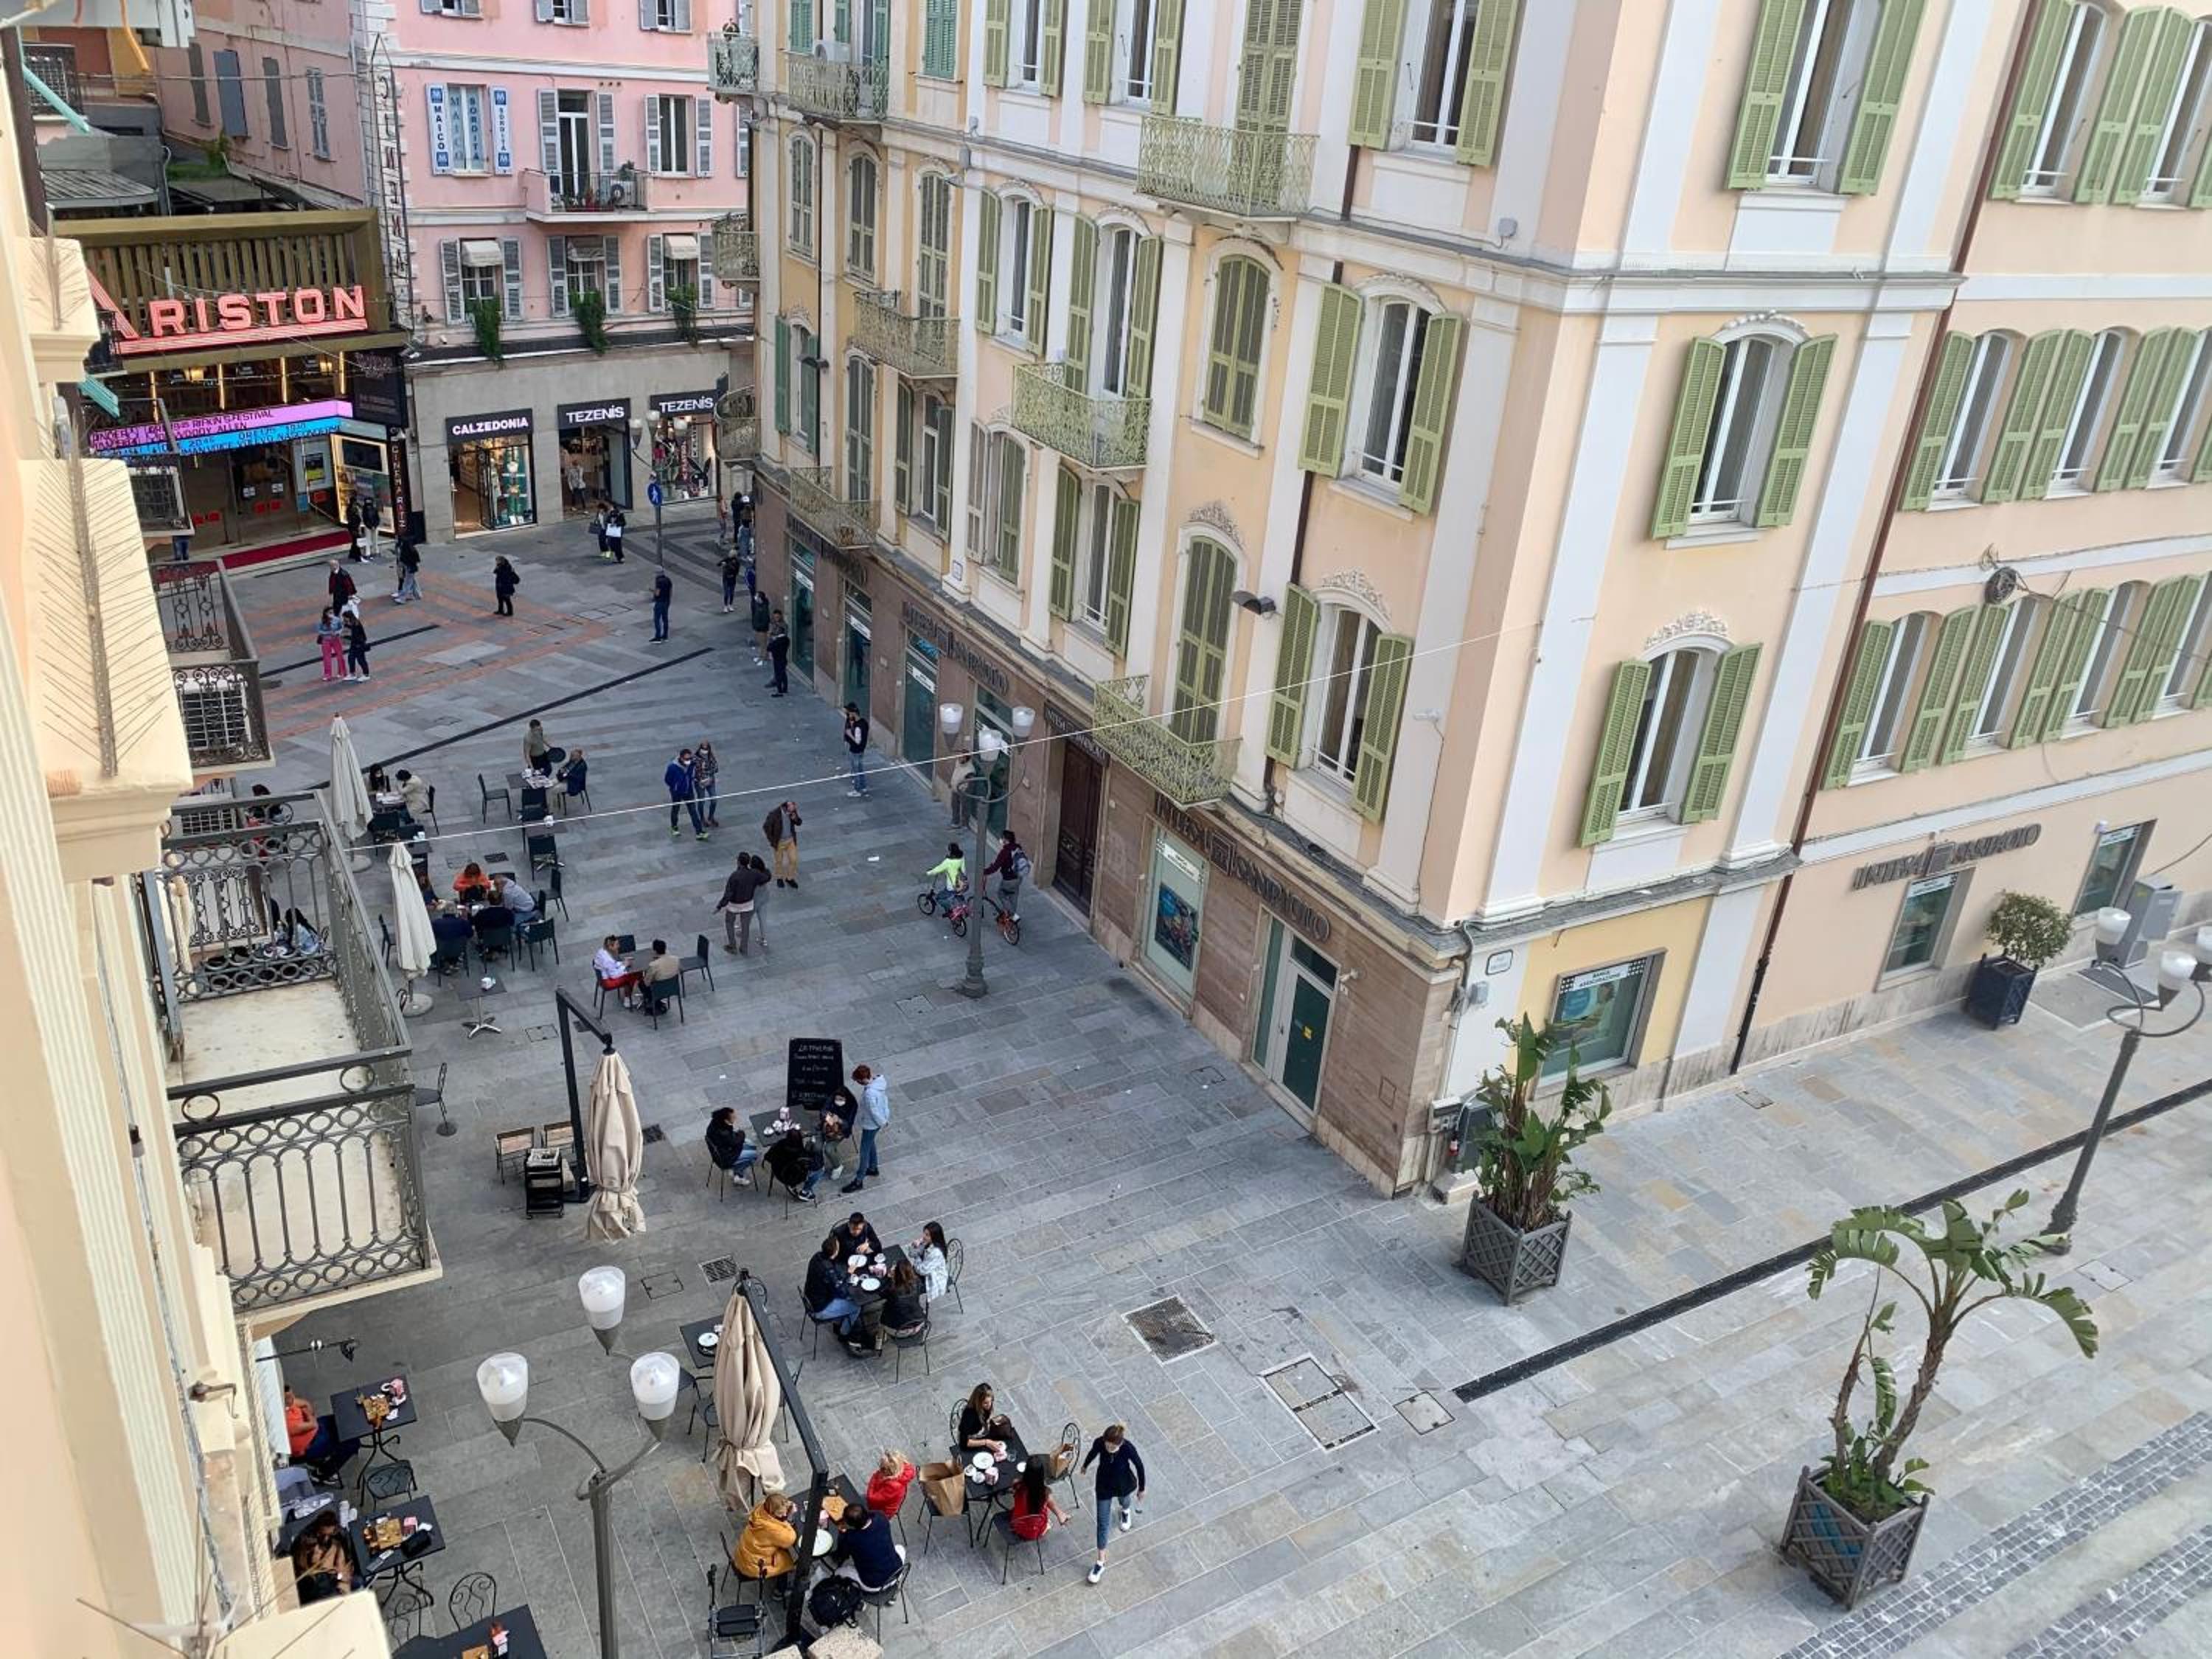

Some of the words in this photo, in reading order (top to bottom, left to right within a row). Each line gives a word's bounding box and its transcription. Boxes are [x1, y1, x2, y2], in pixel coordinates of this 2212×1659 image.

[434, 105, 445, 150] MAICO
[566, 405, 625, 423] TEZENIS
[659, 396, 714, 413] TEZENIS
[218, 421, 248, 434] ALLEN
[451, 416, 529, 436] CALZEDONIA
[392, 445, 403, 494] CINEMA
